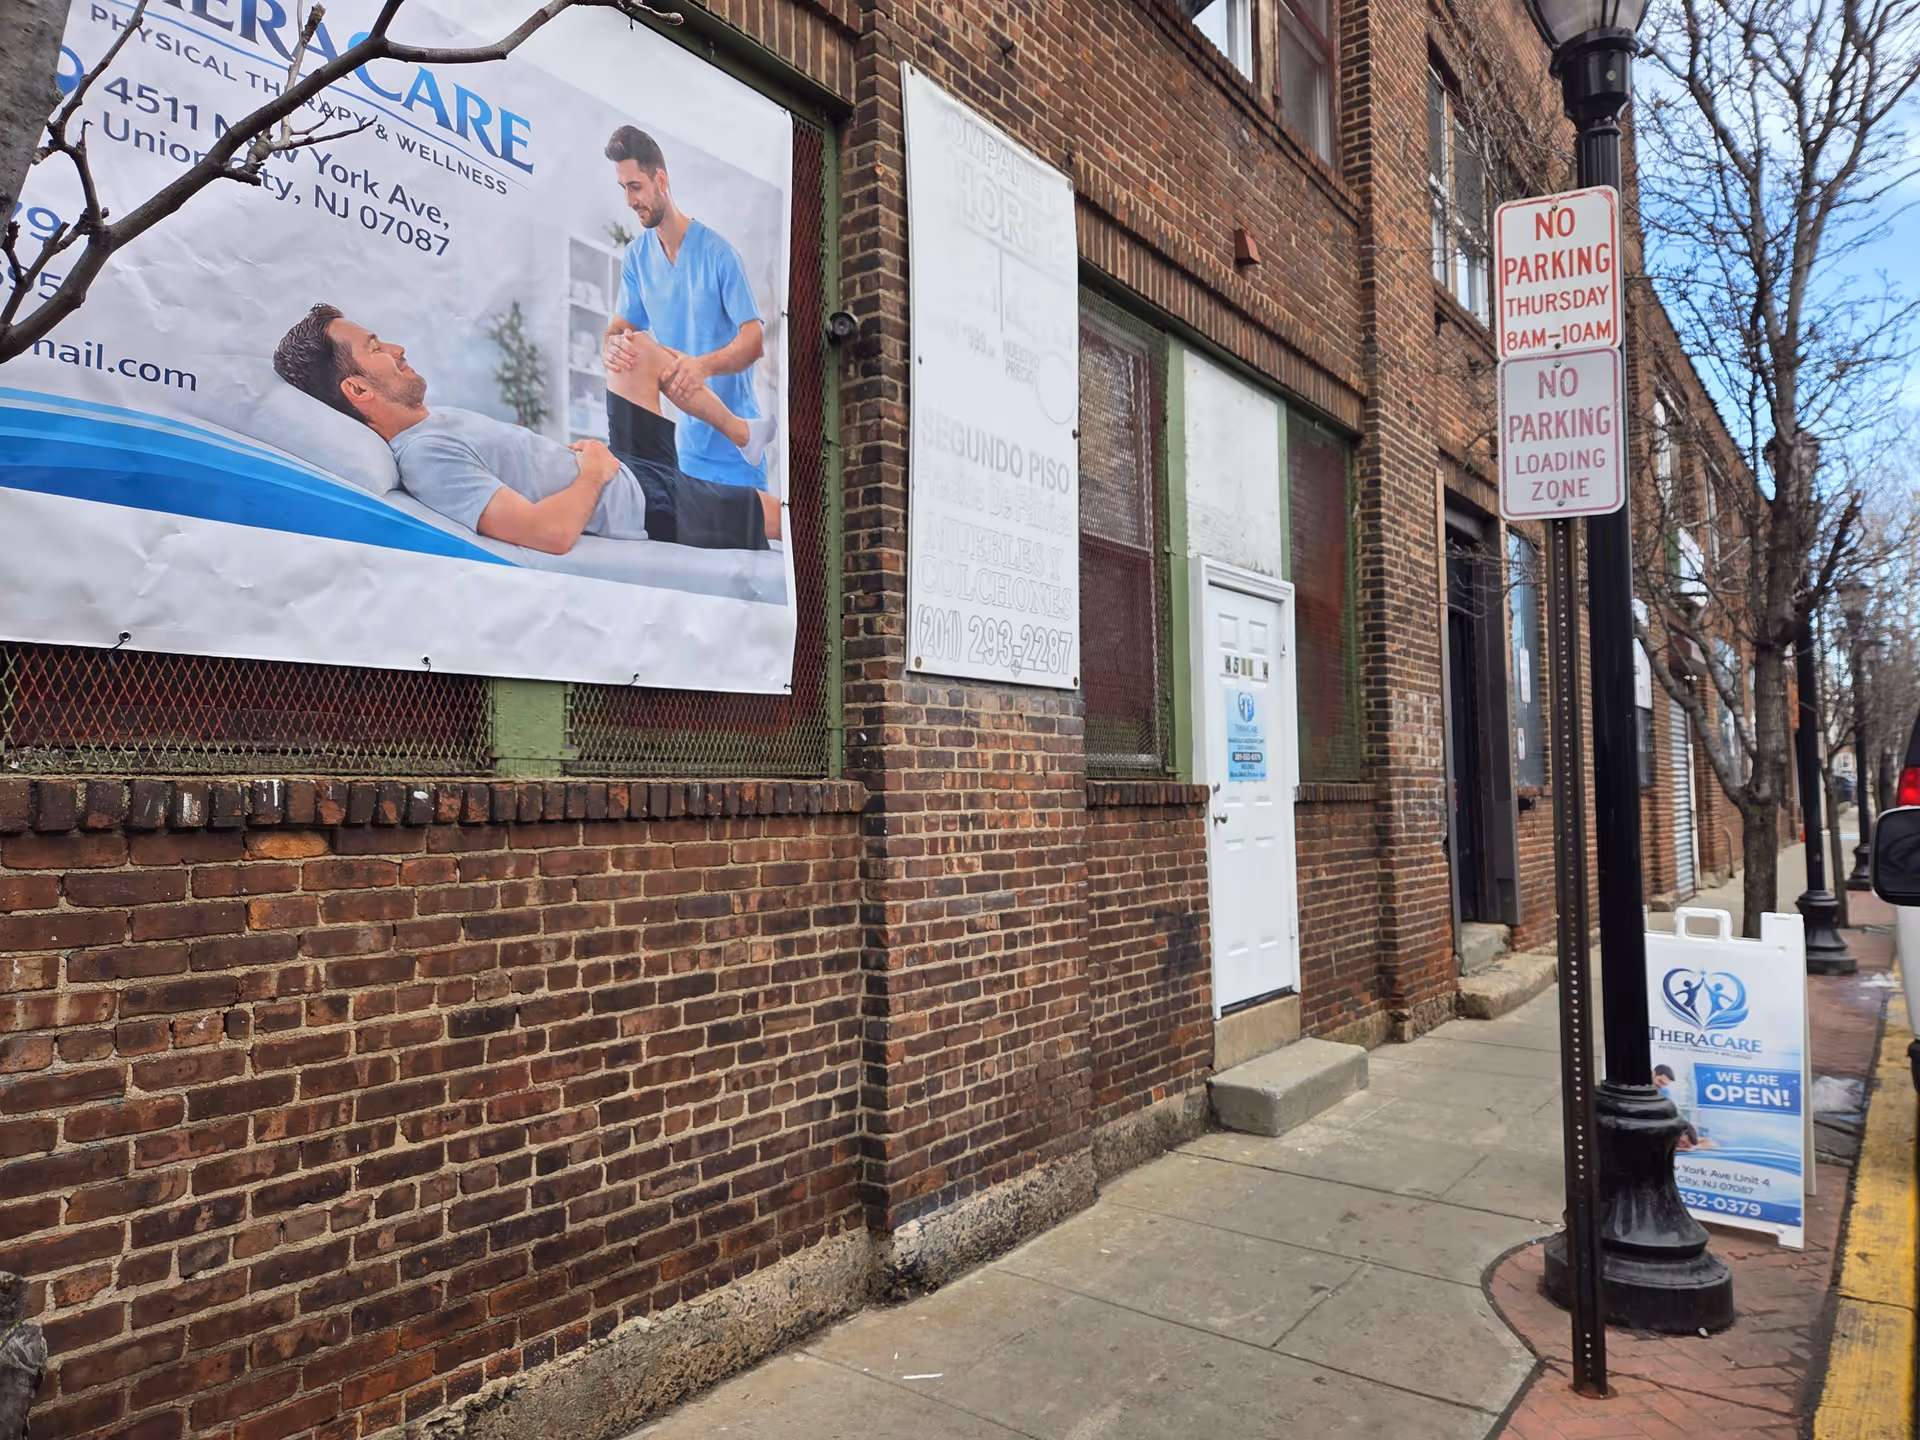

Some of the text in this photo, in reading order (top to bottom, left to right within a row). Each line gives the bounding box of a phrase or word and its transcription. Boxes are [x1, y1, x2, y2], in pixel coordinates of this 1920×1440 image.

[91, 3, 508, 195] PHYSICAL THRAPY & WELLNESS
[103, 77, 450, 230] 4511 Nw York Ave,
[314, 184, 350, 219] NJ
[359, 205, 450, 256] 07087
[1535, 207, 1576, 241] NO
[1504, 243, 1611, 286] PARKING
[1506, 285, 1610, 318] THURSDAY
[1538, 367, 1579, 400] NO
[1509, 405, 1611, 443] PARKING
[920, 406, 1024, 478] SEGUNDO
[1029, 450, 1070, 494] PISO
[1515, 448, 1606, 475] LOADING
[1531, 477, 1591, 501] ZONE
[917, 554, 1074, 620] COLCHONES
[916, 603, 1073, 675] (201) 293-2287
[1648, 1025, 1763, 1054] THERACARE
[1705, 1083, 1791, 1107] OPEN!
[1716, 1071, 1780, 1087] WE ARE
[1681, 1164, 1708, 1177] York
[1709, 1169, 1732, 1181] Ave
[1733, 1172, 1760, 1185] Unit
[1761, 1178, 1771, 1187] 4
[1702, 1179, 1717, 1189] NJ
[1719, 1182, 1755, 1195] 07087
